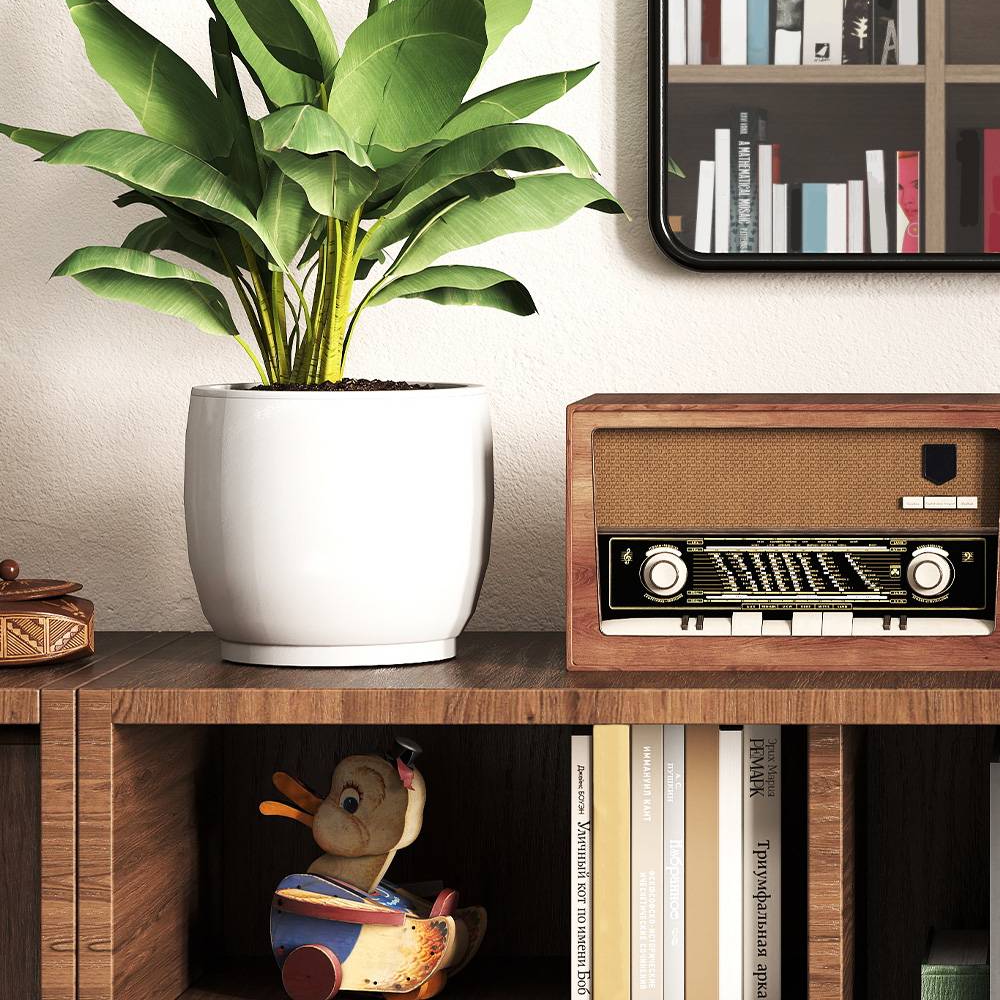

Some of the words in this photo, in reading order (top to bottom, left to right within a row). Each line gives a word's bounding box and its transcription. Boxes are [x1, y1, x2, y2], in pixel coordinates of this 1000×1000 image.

[738, 146, 751, 196] MATHEMATICAL
[738, 198, 751, 224] MOSAIC
[766, 738, 778, 762] Эрих
[576, 764, 585, 790] Джеймс
[642, 746, 652, 796] ИММАНУИЛ
[749, 738, 765, 798] РЕМАРК
[766, 764, 778, 798] Мария
[577, 791, 585, 815] БОУЭН
[642, 799, 652, 823] КАНТ
[576, 820, 592, 879] Уличный
[577, 883, 587, 905] кот
[752, 840, 771, 957] Триумфальная
[577, 907, 587, 924] по
[577, 925, 587, 967] имени
[577, 970, 592, 996] Боб
[752, 964, 769, 999] арка
